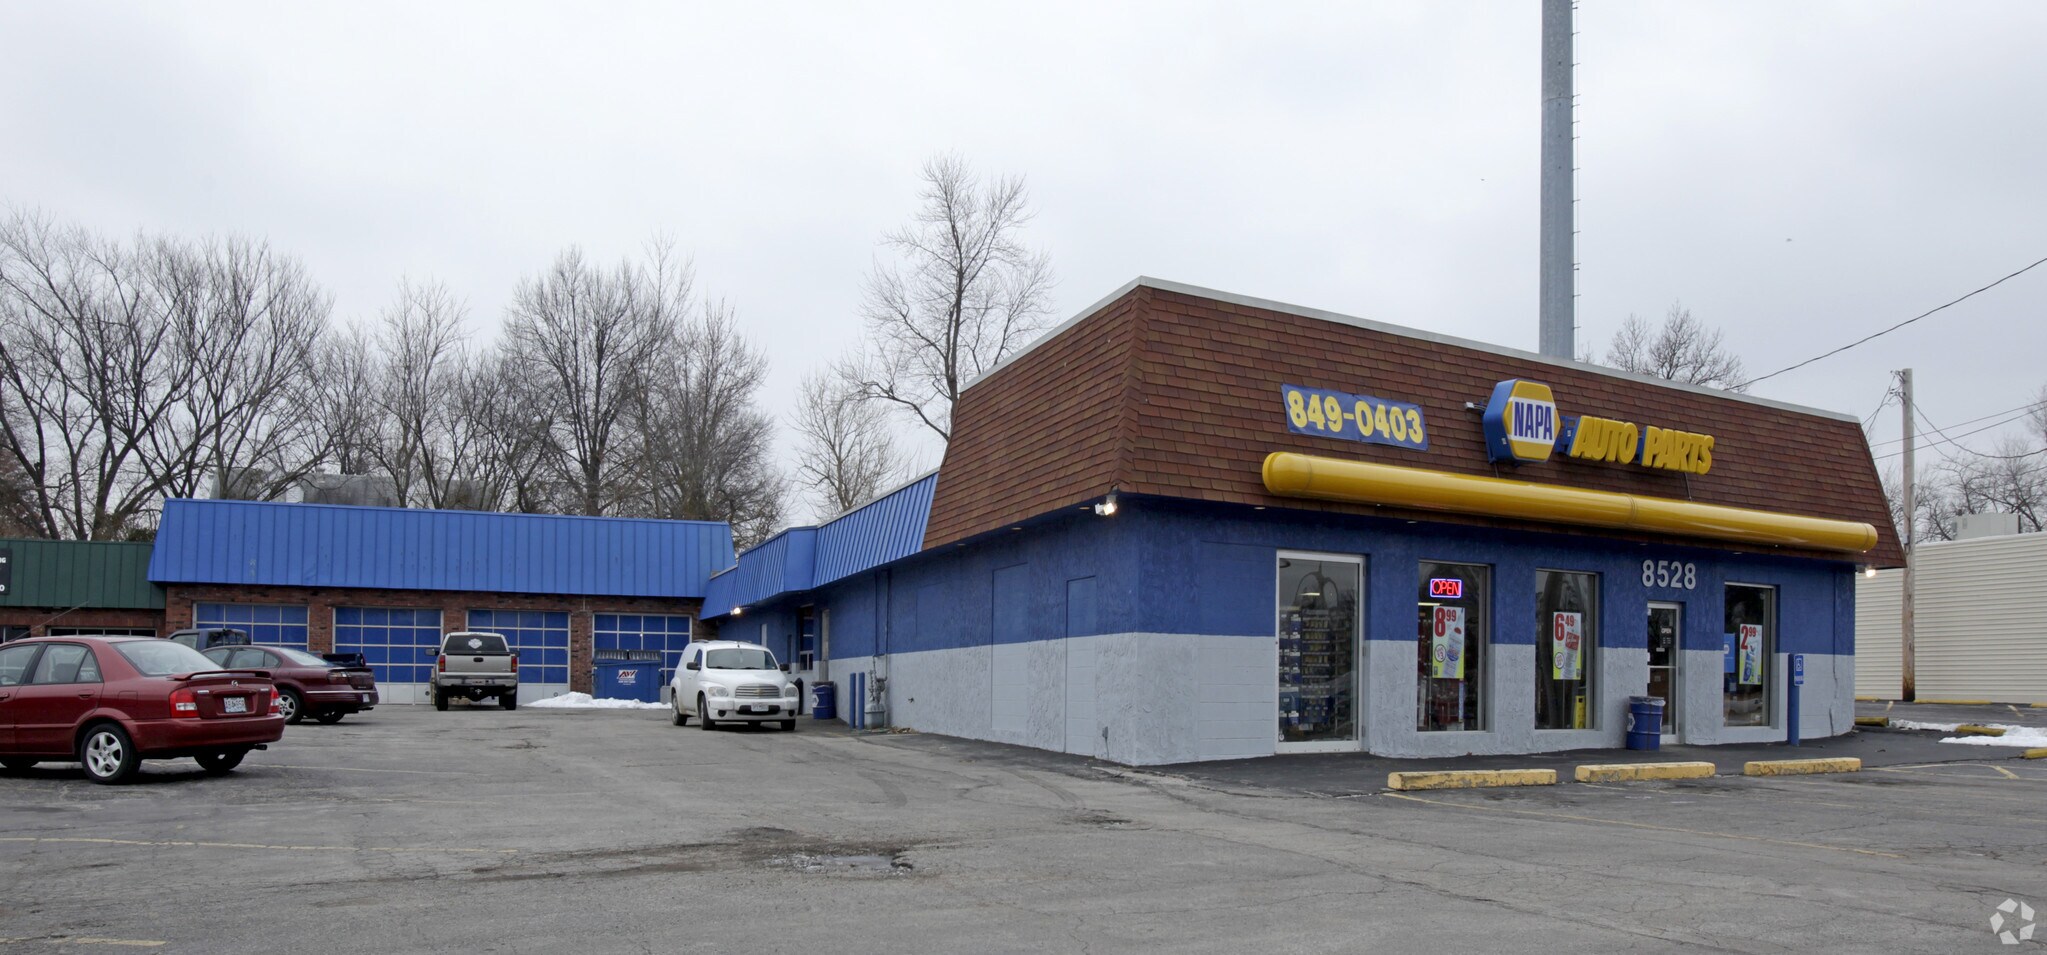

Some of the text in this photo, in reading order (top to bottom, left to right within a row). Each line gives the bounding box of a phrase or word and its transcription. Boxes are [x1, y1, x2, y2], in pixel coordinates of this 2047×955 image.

[1287, 390, 1424, 444] 849-0403
[1514, 401, 1553, 440] NAPA
[1570, 415, 1715, 475] AUTO PARTS
[1432, 579, 1460, 596] OPEN
[1642, 559, 1696, 590] 8528
